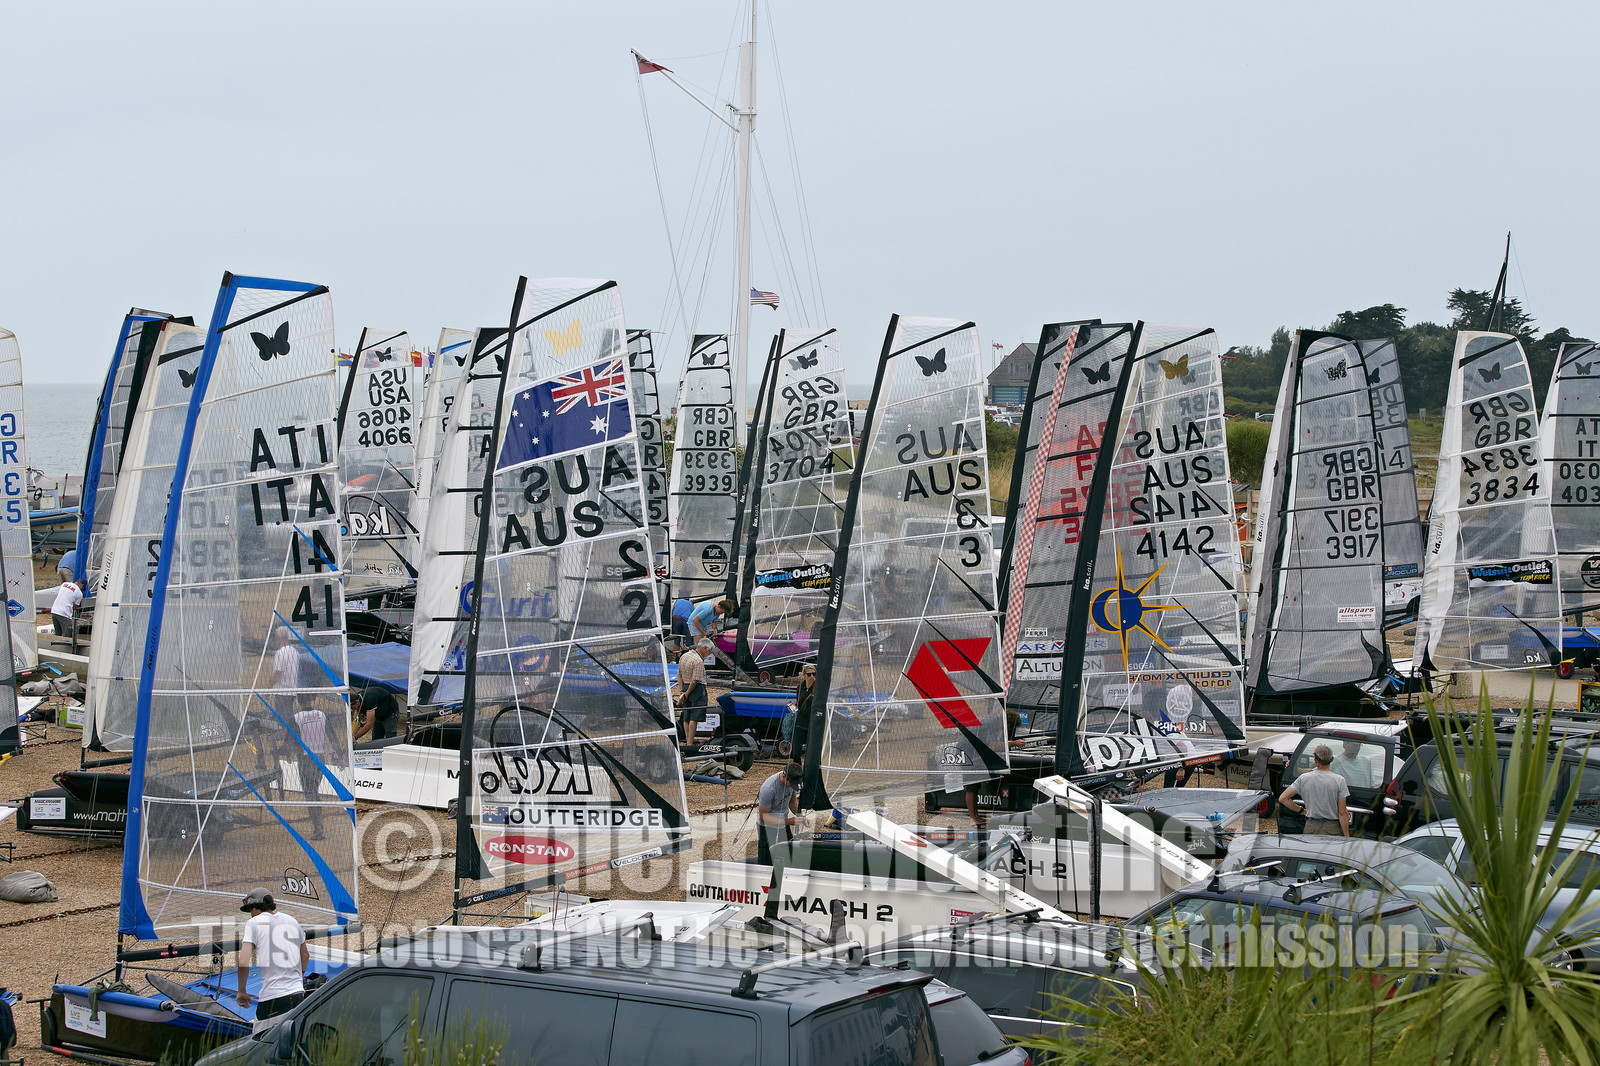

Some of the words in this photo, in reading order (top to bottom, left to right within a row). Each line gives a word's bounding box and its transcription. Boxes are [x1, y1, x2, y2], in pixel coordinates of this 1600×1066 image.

[369, 386, 411, 406] USA
[783, 400, 839, 430] GBR
[358, 426, 412, 447] 4066
[694, 430, 731, 447] GBR
[1474, 417, 1532, 448] GBR
[767, 451, 836, 485] 3704
[903, 459, 982, 502] AUS
[1143, 455, 1213, 495] AUS
[685, 475, 732, 492] 3939
[1327, 474, 1376, 501] GBR
[1466, 472, 1540, 505] 3834
[250, 473, 335, 526] ITA
[501, 500, 605, 553] AUS
[959, 536, 982, 568] 3
[1136, 525, 1216, 560] 4142
[1326, 533, 1379, 560] 3917
[292, 585, 334, 628] 41
[623, 590, 653, 630] 2
[509, 808, 660, 826] OUTTERIDGE
[488, 841, 570, 858] RONSTAN
[473, 894, 484, 902] CST
[484, 886, 517, 899] COMPOSITES
[876, 904, 894, 922] 2
